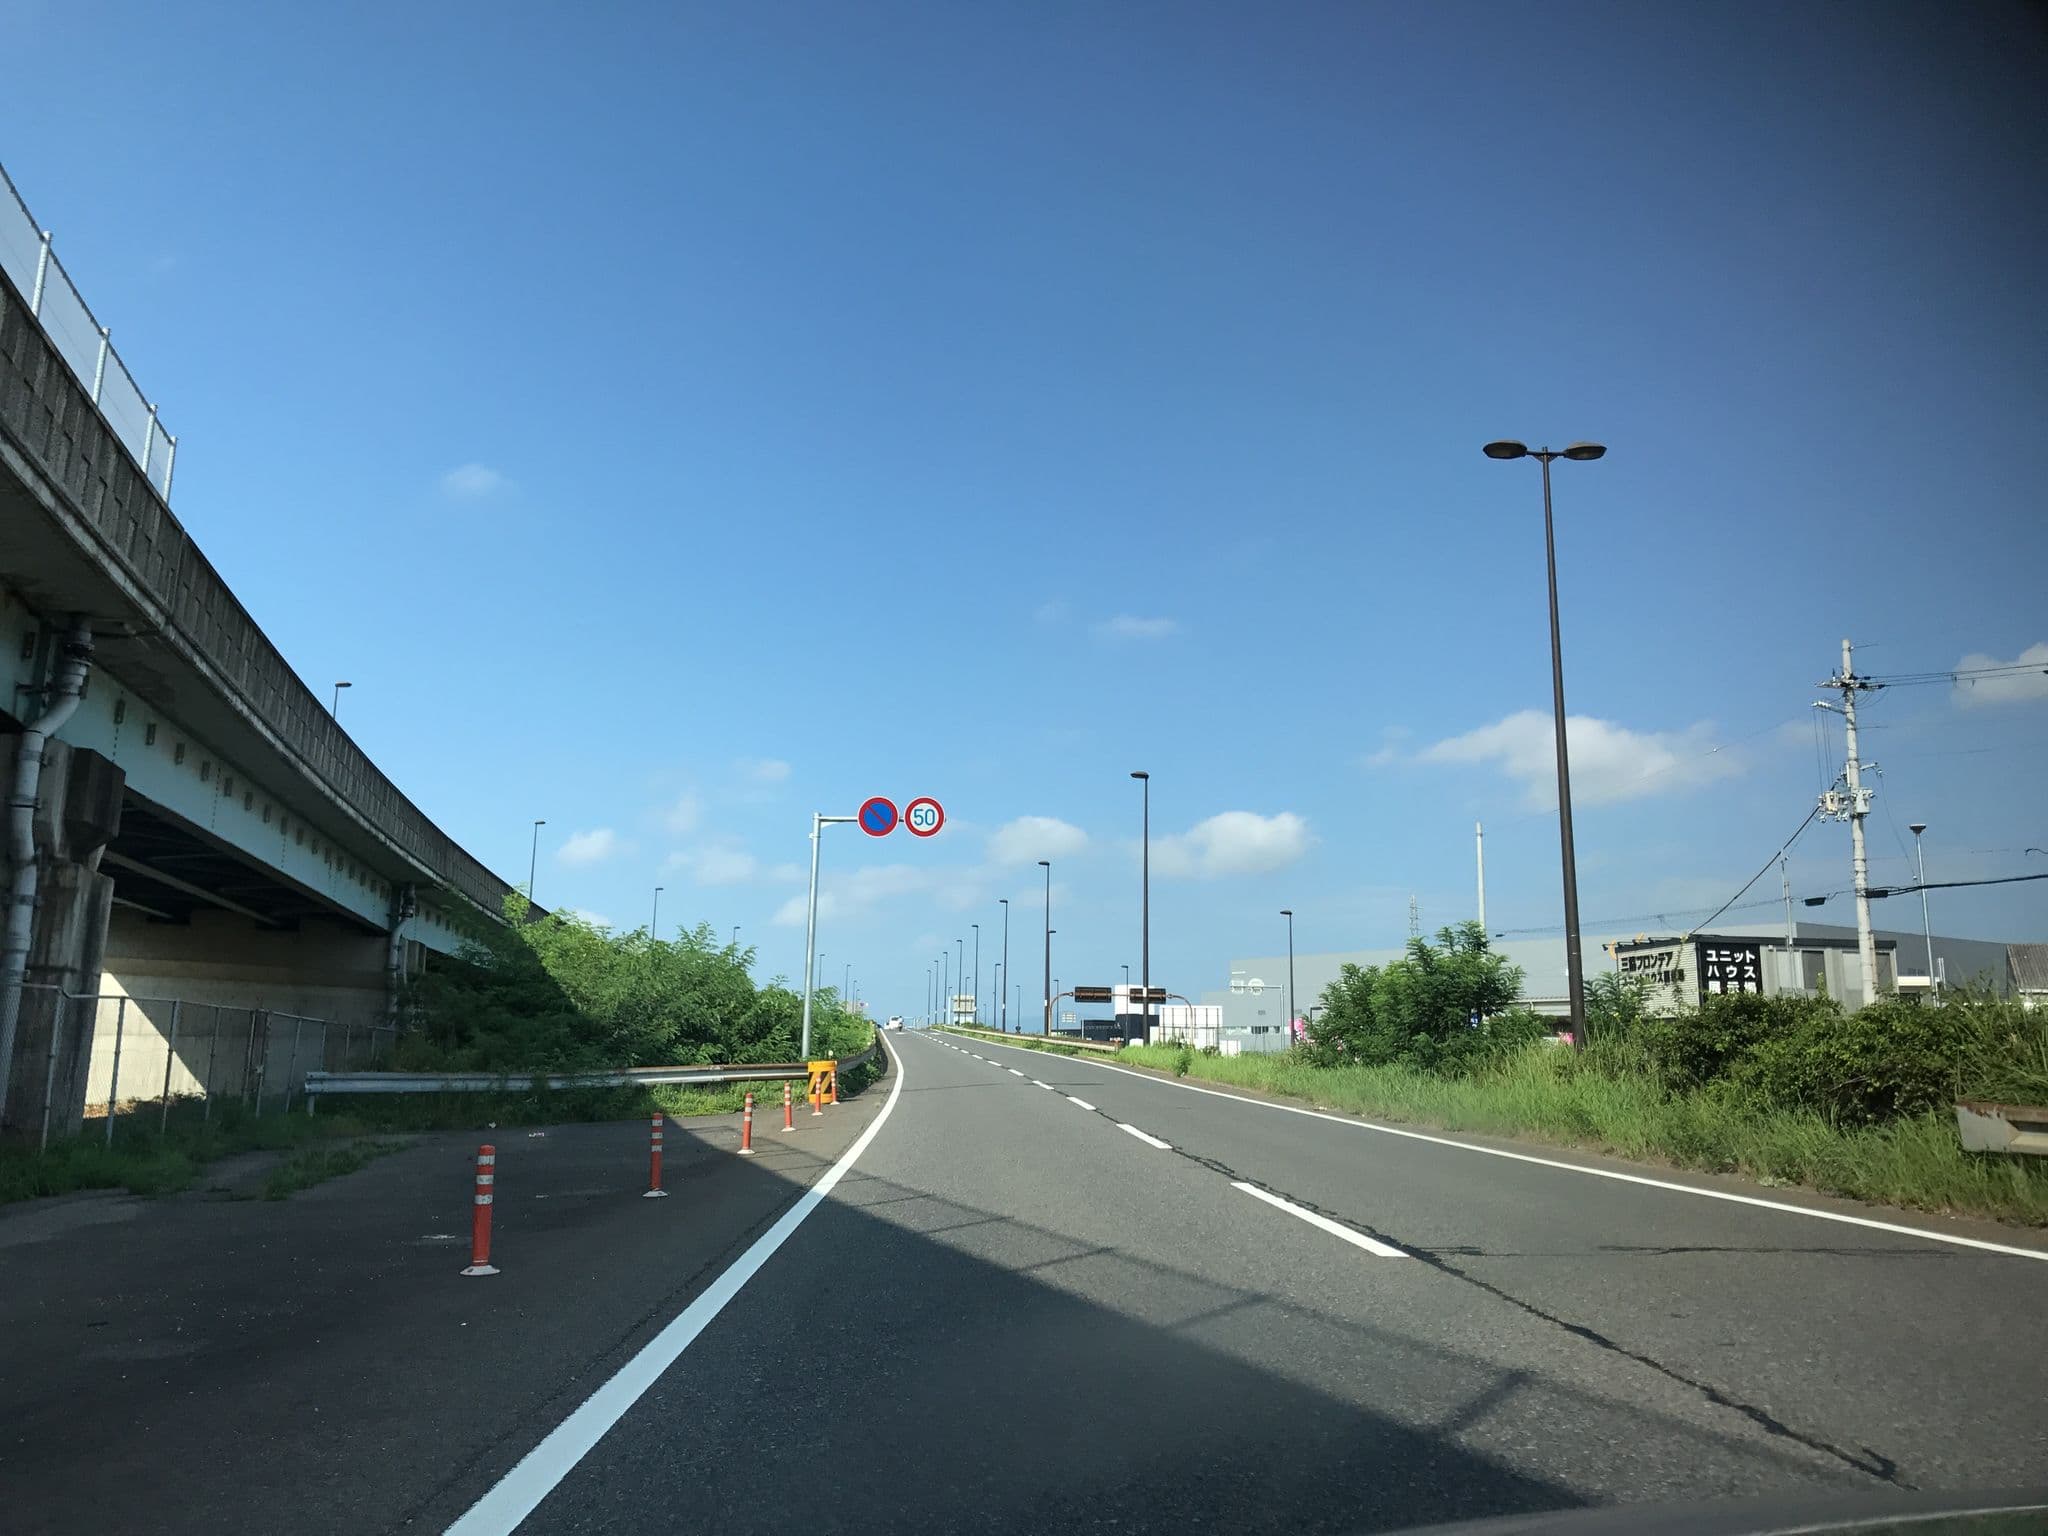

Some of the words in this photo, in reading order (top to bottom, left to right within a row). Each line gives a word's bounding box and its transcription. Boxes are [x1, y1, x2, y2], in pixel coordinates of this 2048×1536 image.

[914, 808, 935, 826] 50
[1706, 949, 1756, 963] ユニット
[1707, 965, 1756, 978] ハウス
